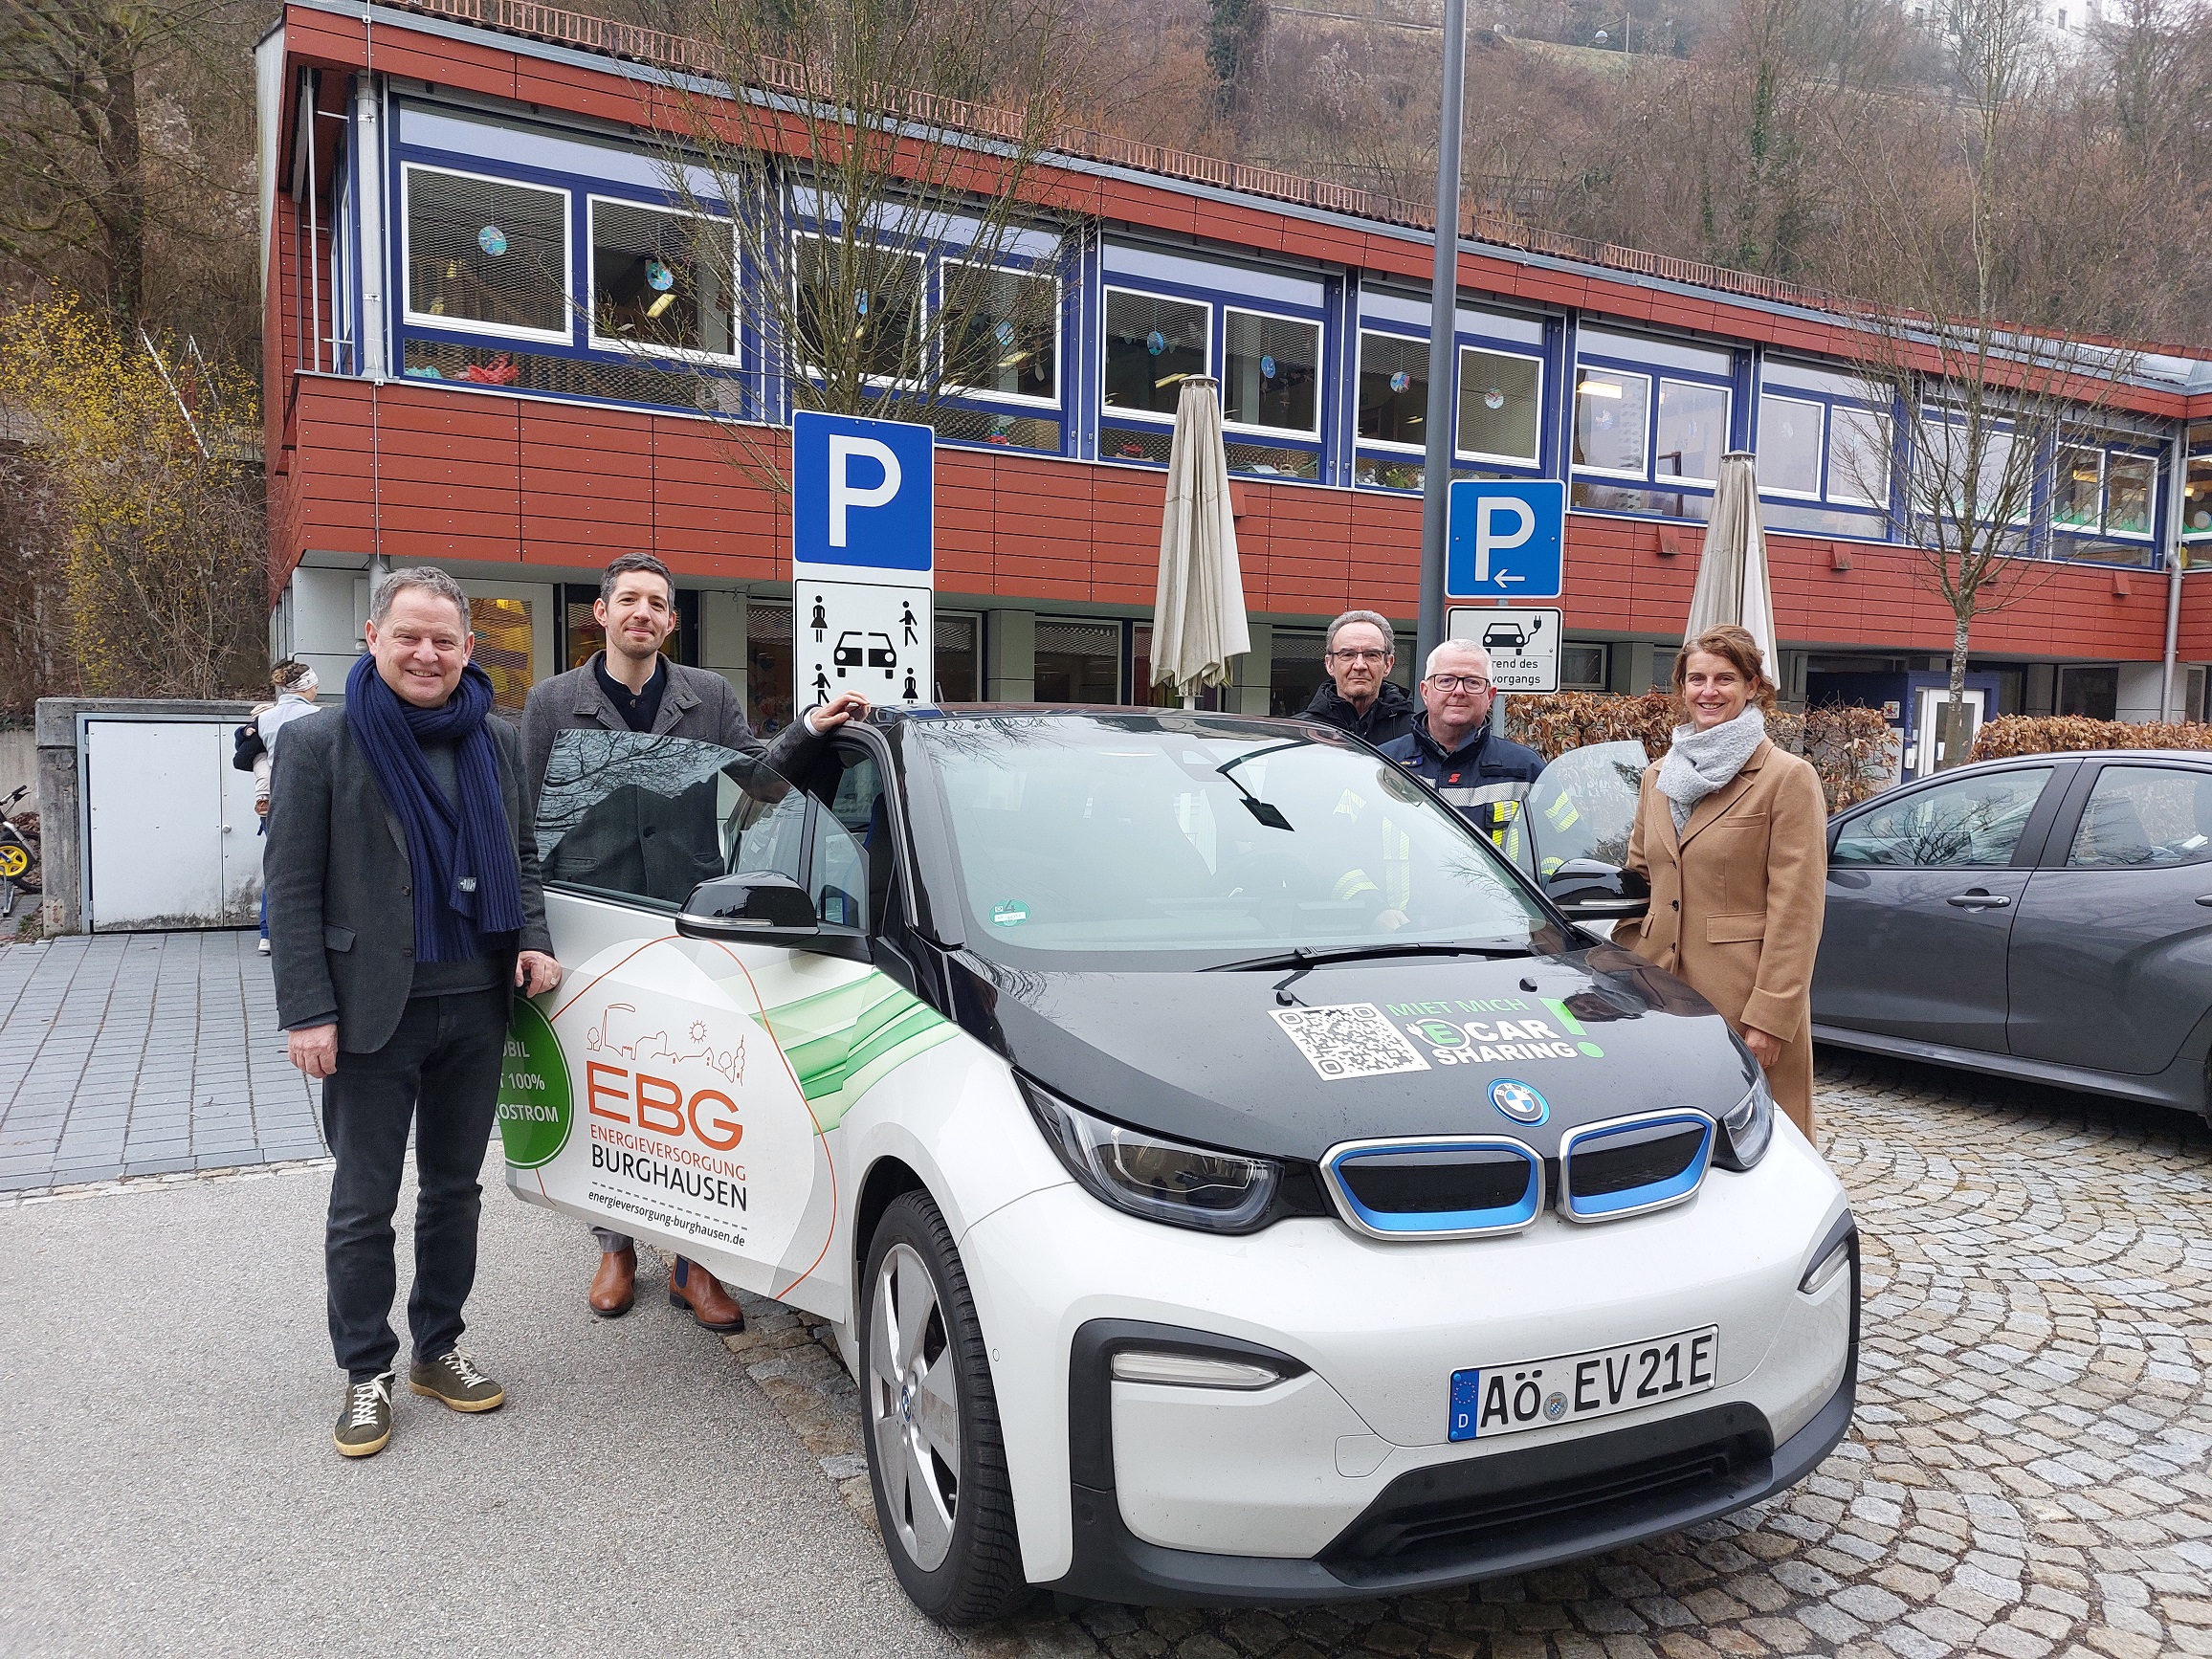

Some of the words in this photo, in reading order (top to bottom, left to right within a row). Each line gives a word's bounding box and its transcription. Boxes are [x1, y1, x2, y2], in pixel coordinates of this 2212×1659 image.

[829, 433, 902, 547] P
[1474, 497, 1536, 582] P
[1519, 658, 1538, 669] des
[1003, 899, 1016, 913] 4
[1384, 1001, 1453, 1017] MIET
[1454, 998, 1531, 1013] MICH
[508, 1073, 545, 1091] 100%
[1431, 1041, 1579, 1066] SHARING
[586, 1060, 743, 1152] EBG
[590, 1123, 746, 1182] ENERGIEVERSORGUNG
[591, 1143, 747, 1212] BURGHAUSEN
[588, 1190, 746, 1247] energieversorgung-burghausen.de
[1458, 1413, 1469, 1428] D
[1480, 1369, 1543, 1427] AÖ
